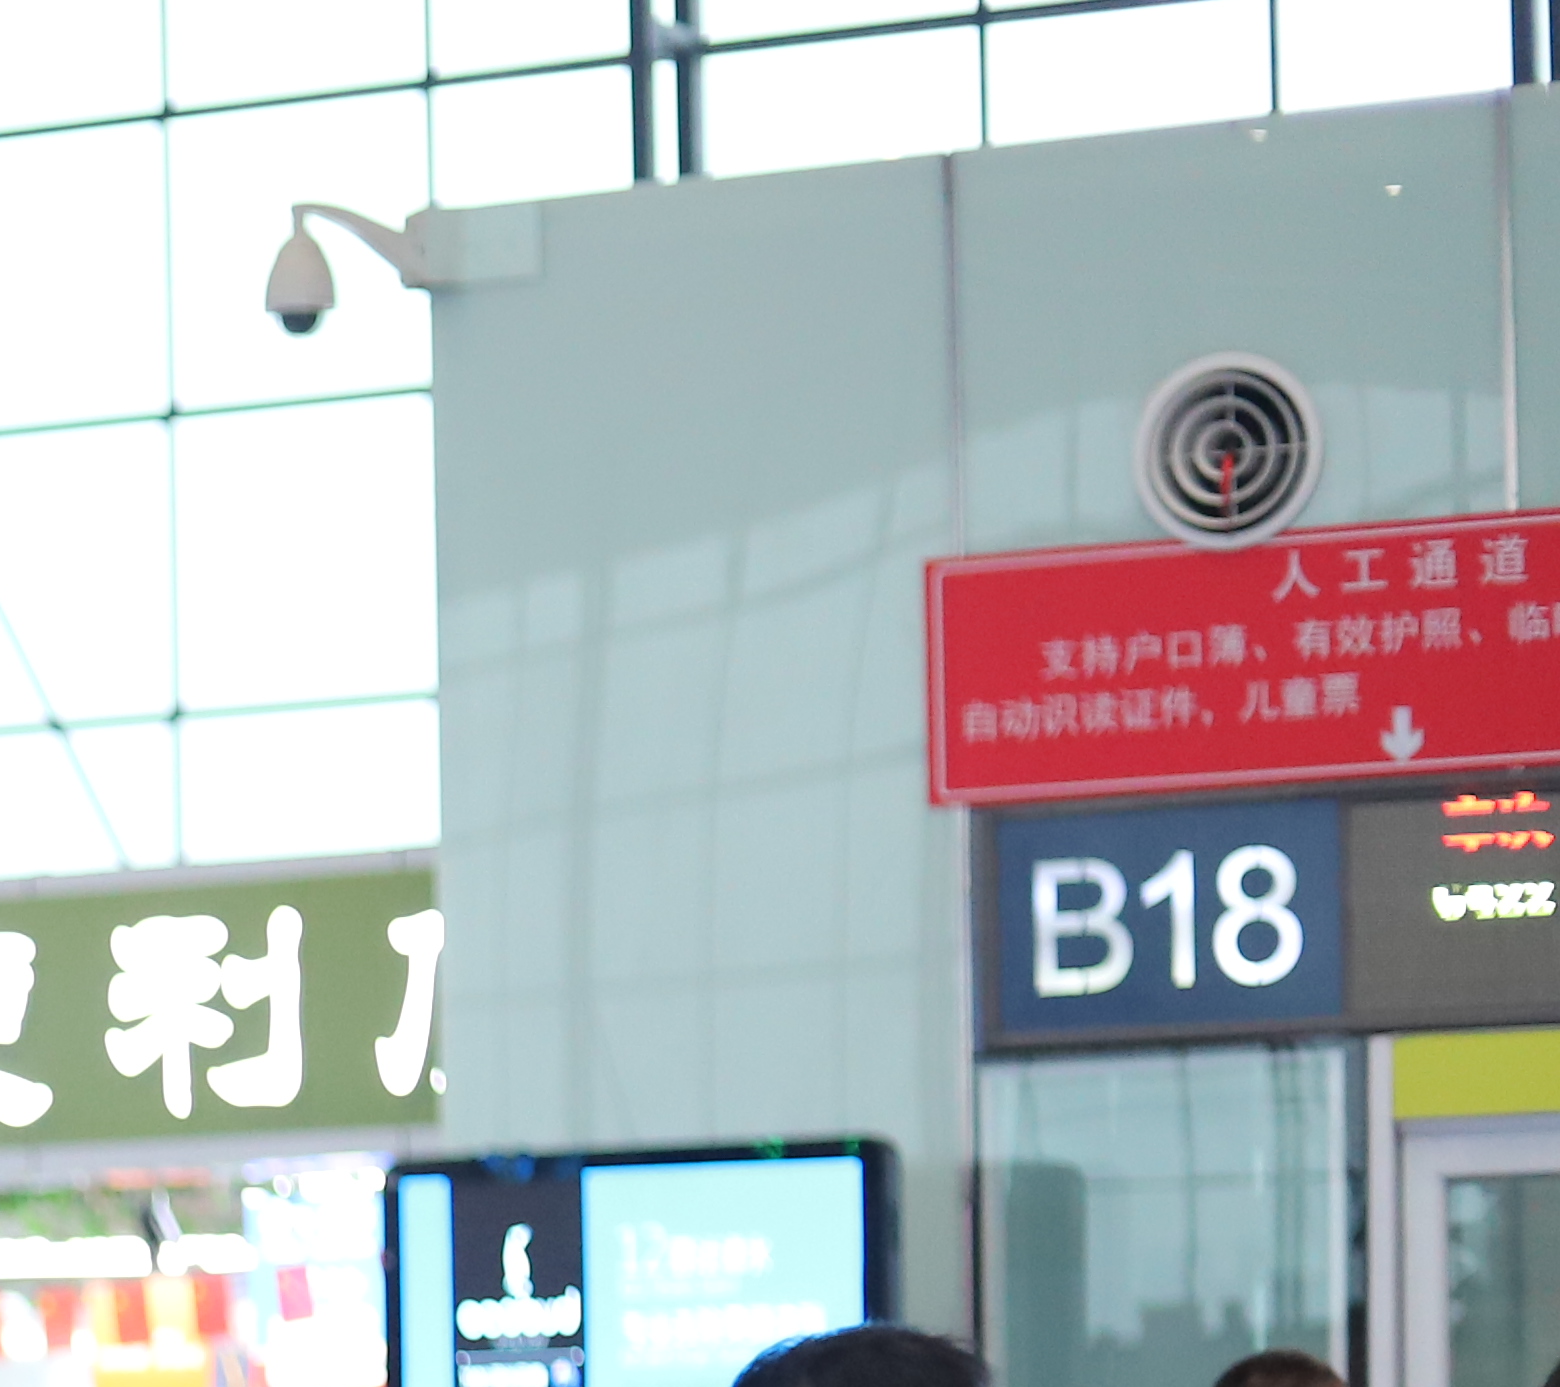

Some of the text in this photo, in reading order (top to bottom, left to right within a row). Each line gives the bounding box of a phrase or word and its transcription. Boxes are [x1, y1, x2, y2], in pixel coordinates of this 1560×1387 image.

[1273, 534, 1529, 602] 人工通道
[1031, 844, 1304, 998] B18
